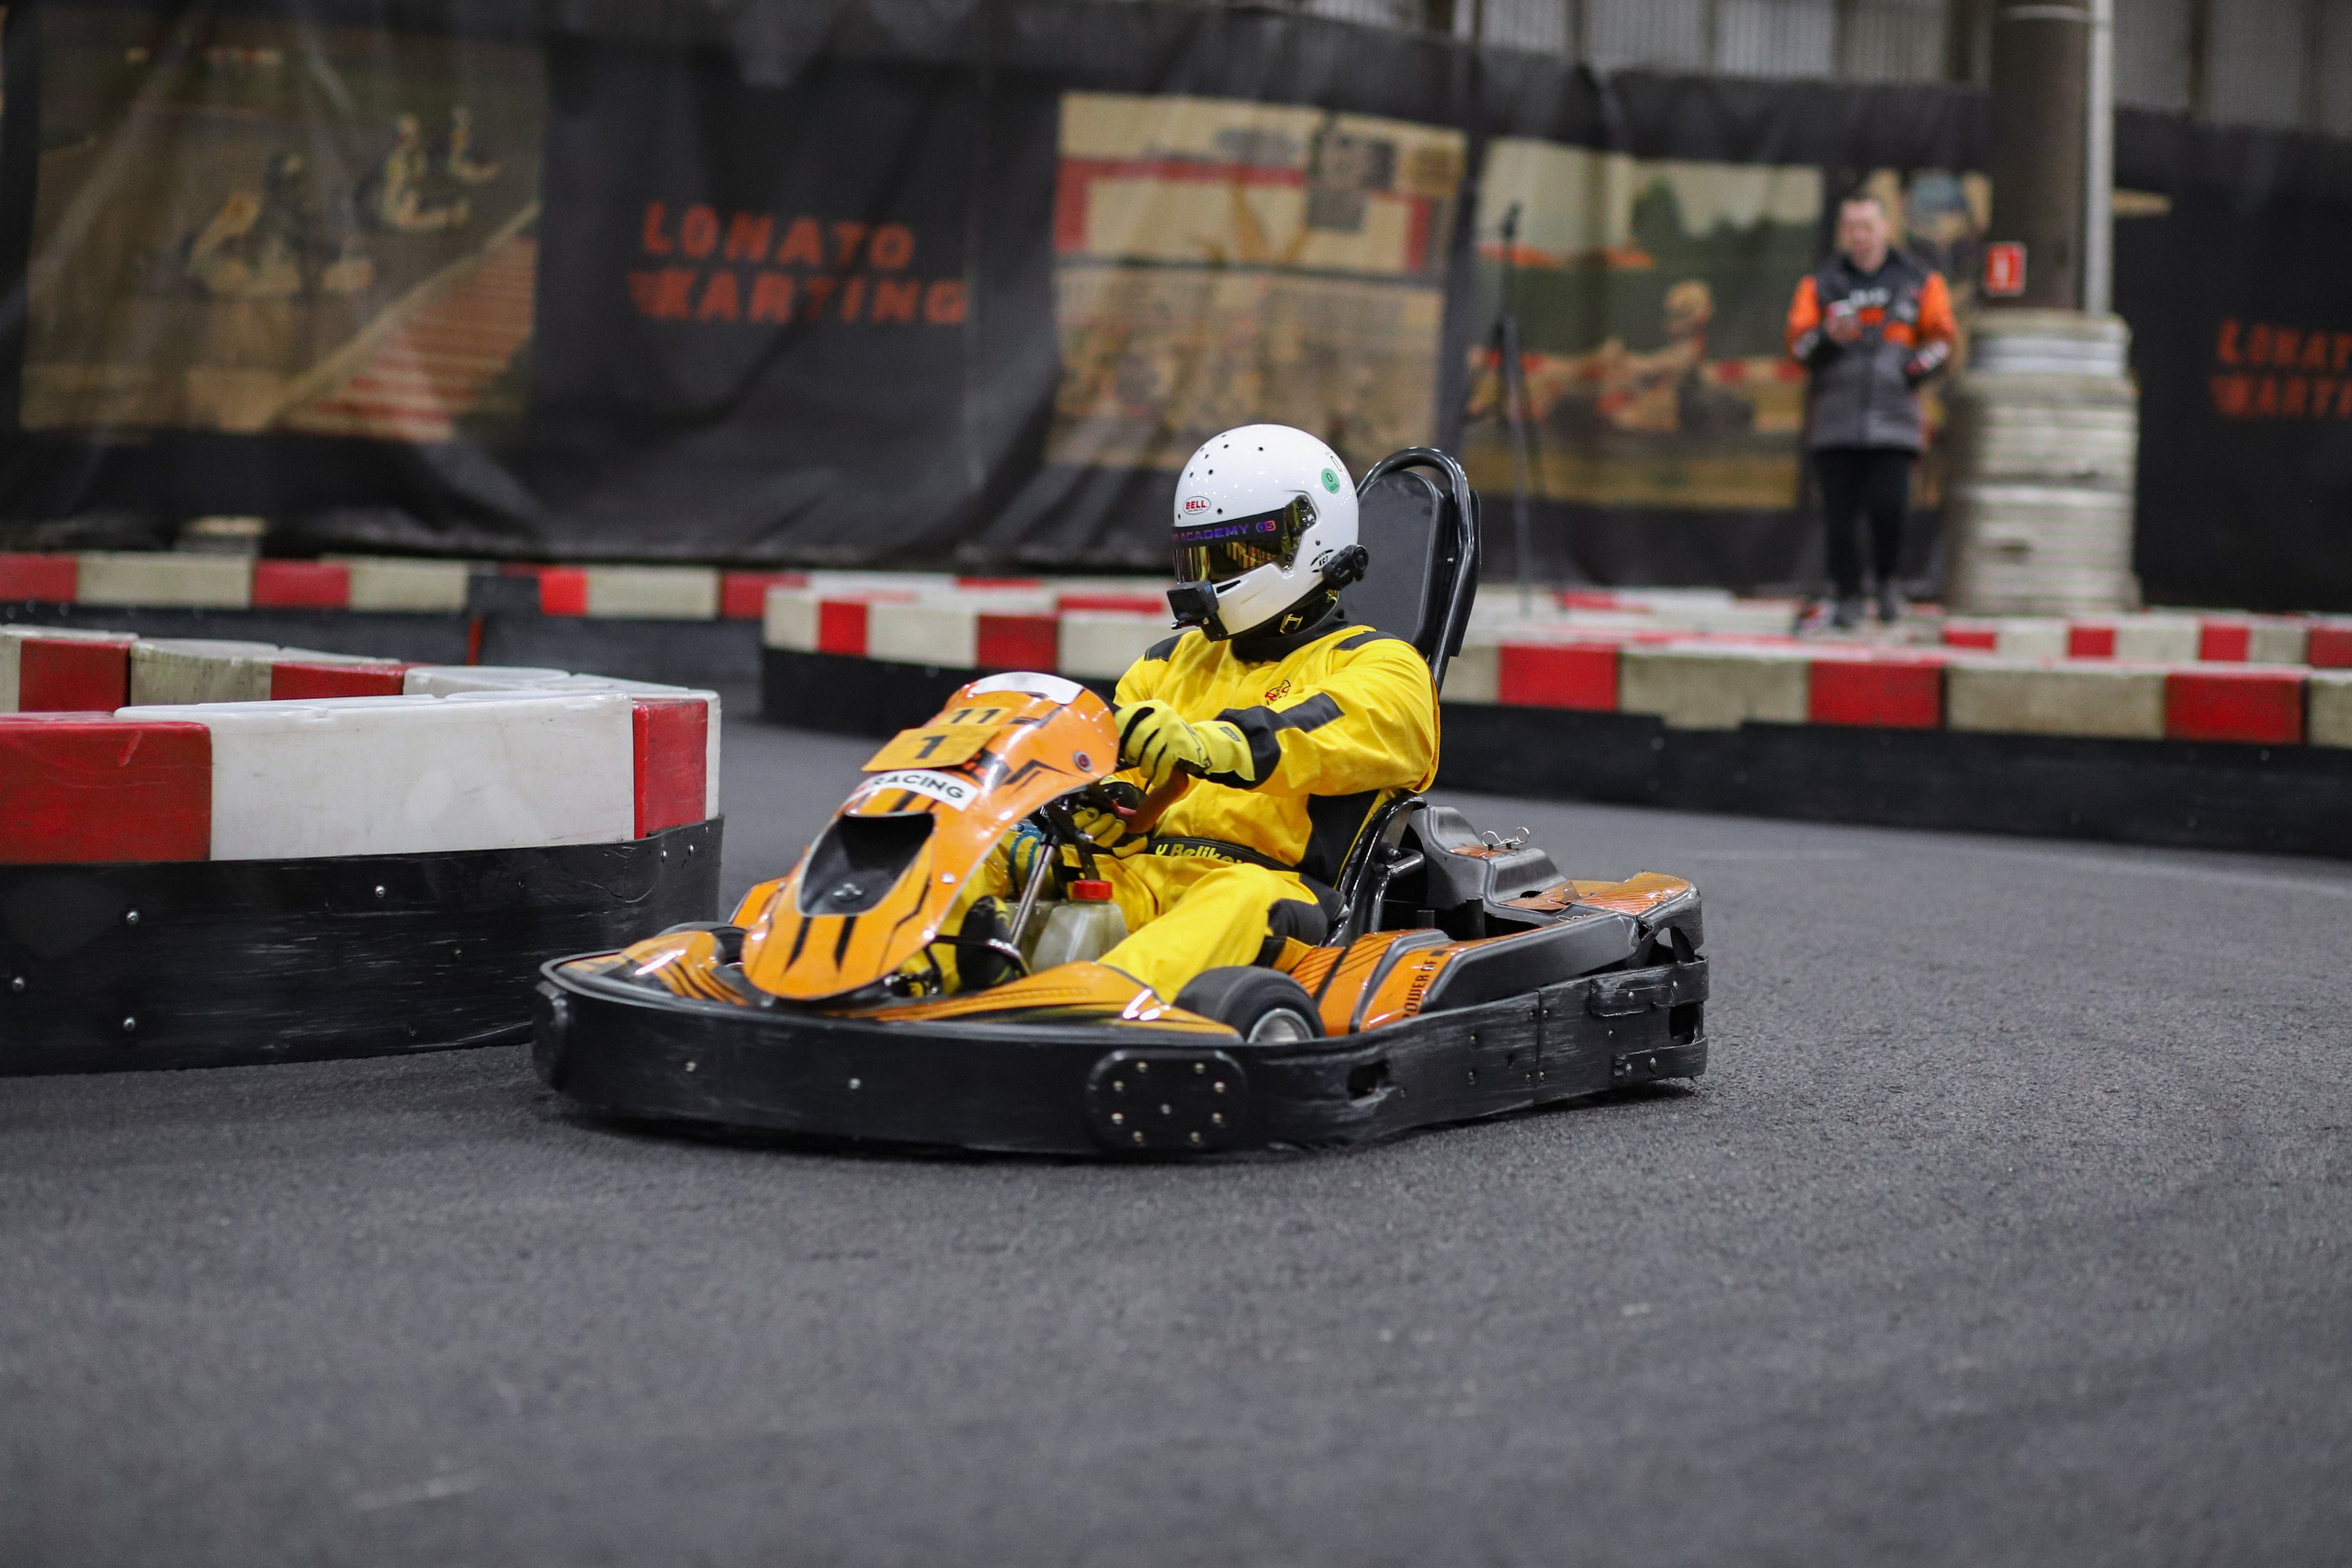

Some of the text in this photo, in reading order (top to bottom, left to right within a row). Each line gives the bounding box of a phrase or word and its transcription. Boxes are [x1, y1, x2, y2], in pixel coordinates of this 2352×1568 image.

[643, 200, 915, 271] LONATO
[628, 265, 967, 325] KARTING
[1186, 500, 1206, 510] BELL
[950, 708, 1001, 725] 11
[915, 735, 948, 760] 1
[873, 773, 965, 799] RACING
